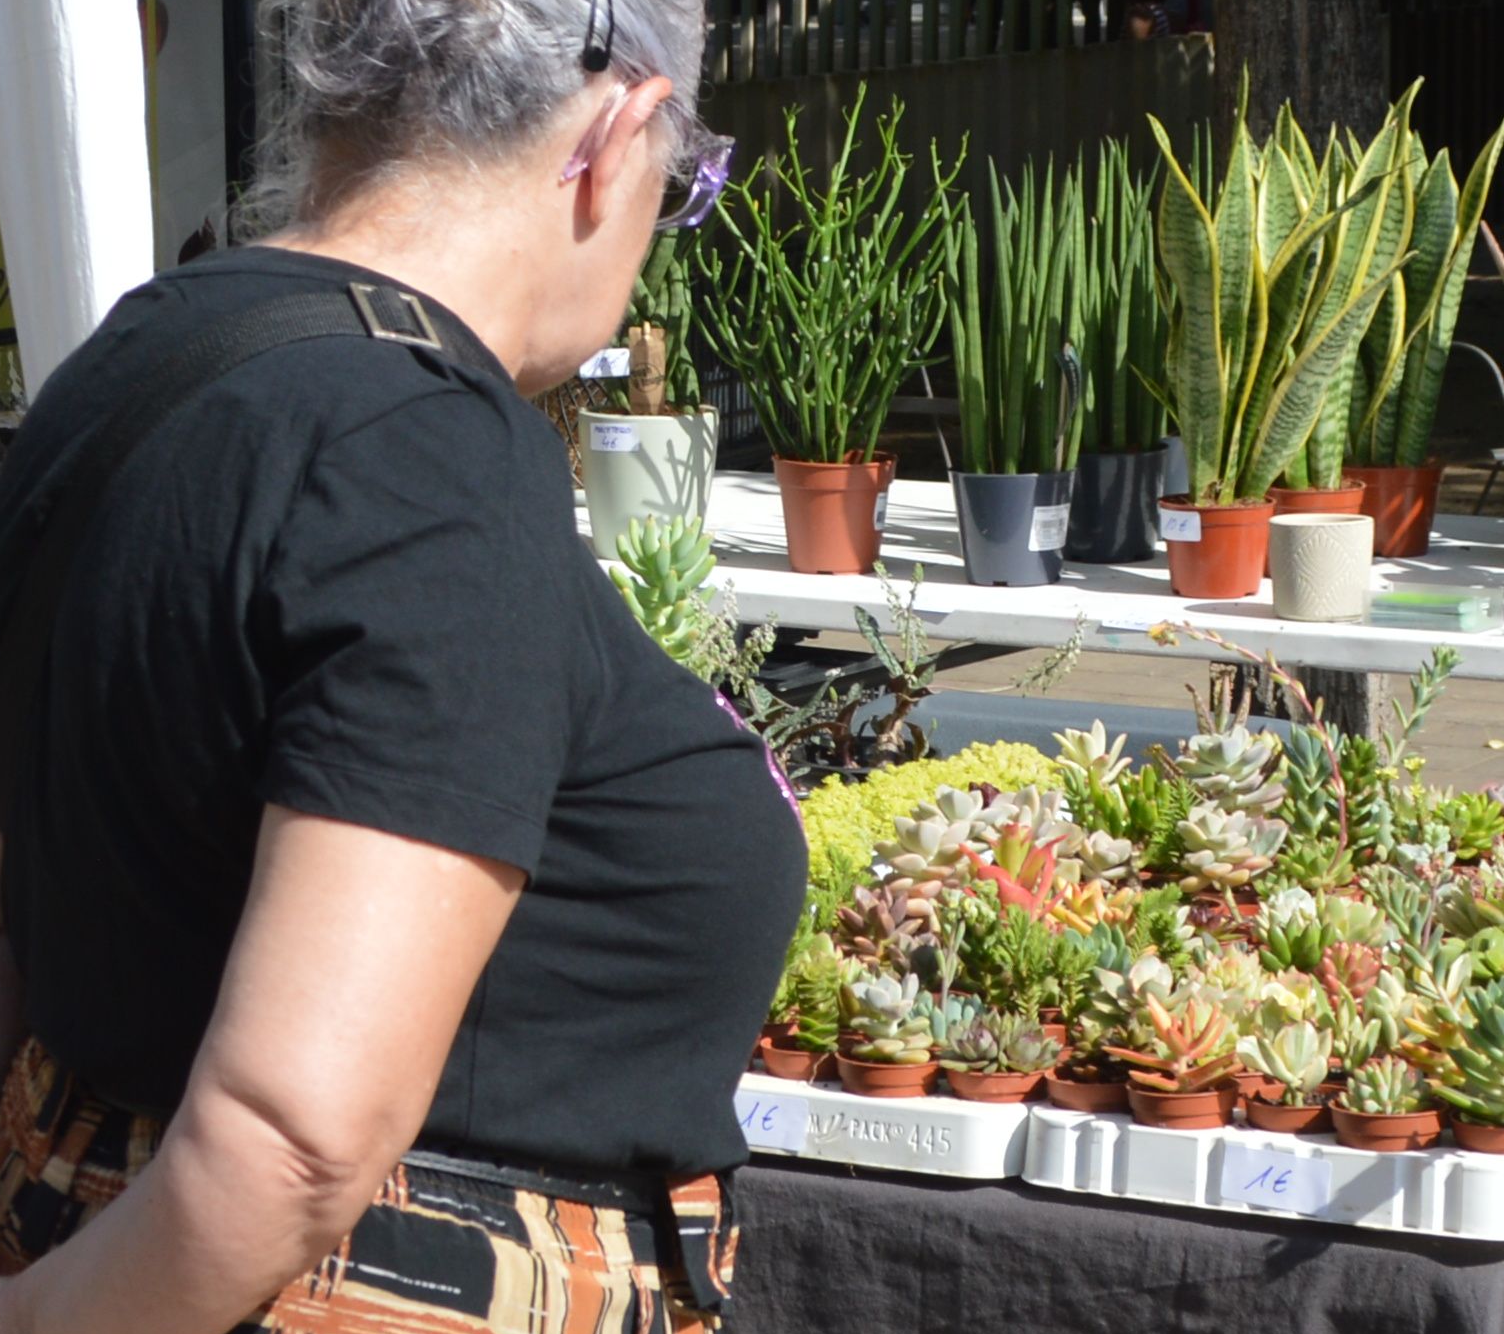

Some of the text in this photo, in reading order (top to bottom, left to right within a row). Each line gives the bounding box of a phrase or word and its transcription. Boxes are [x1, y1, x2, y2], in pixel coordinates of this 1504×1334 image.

[741, 1101, 780, 1132] 1€
[907, 1121, 952, 1157] 445
[1243, 1165, 1293, 1194] 1€
